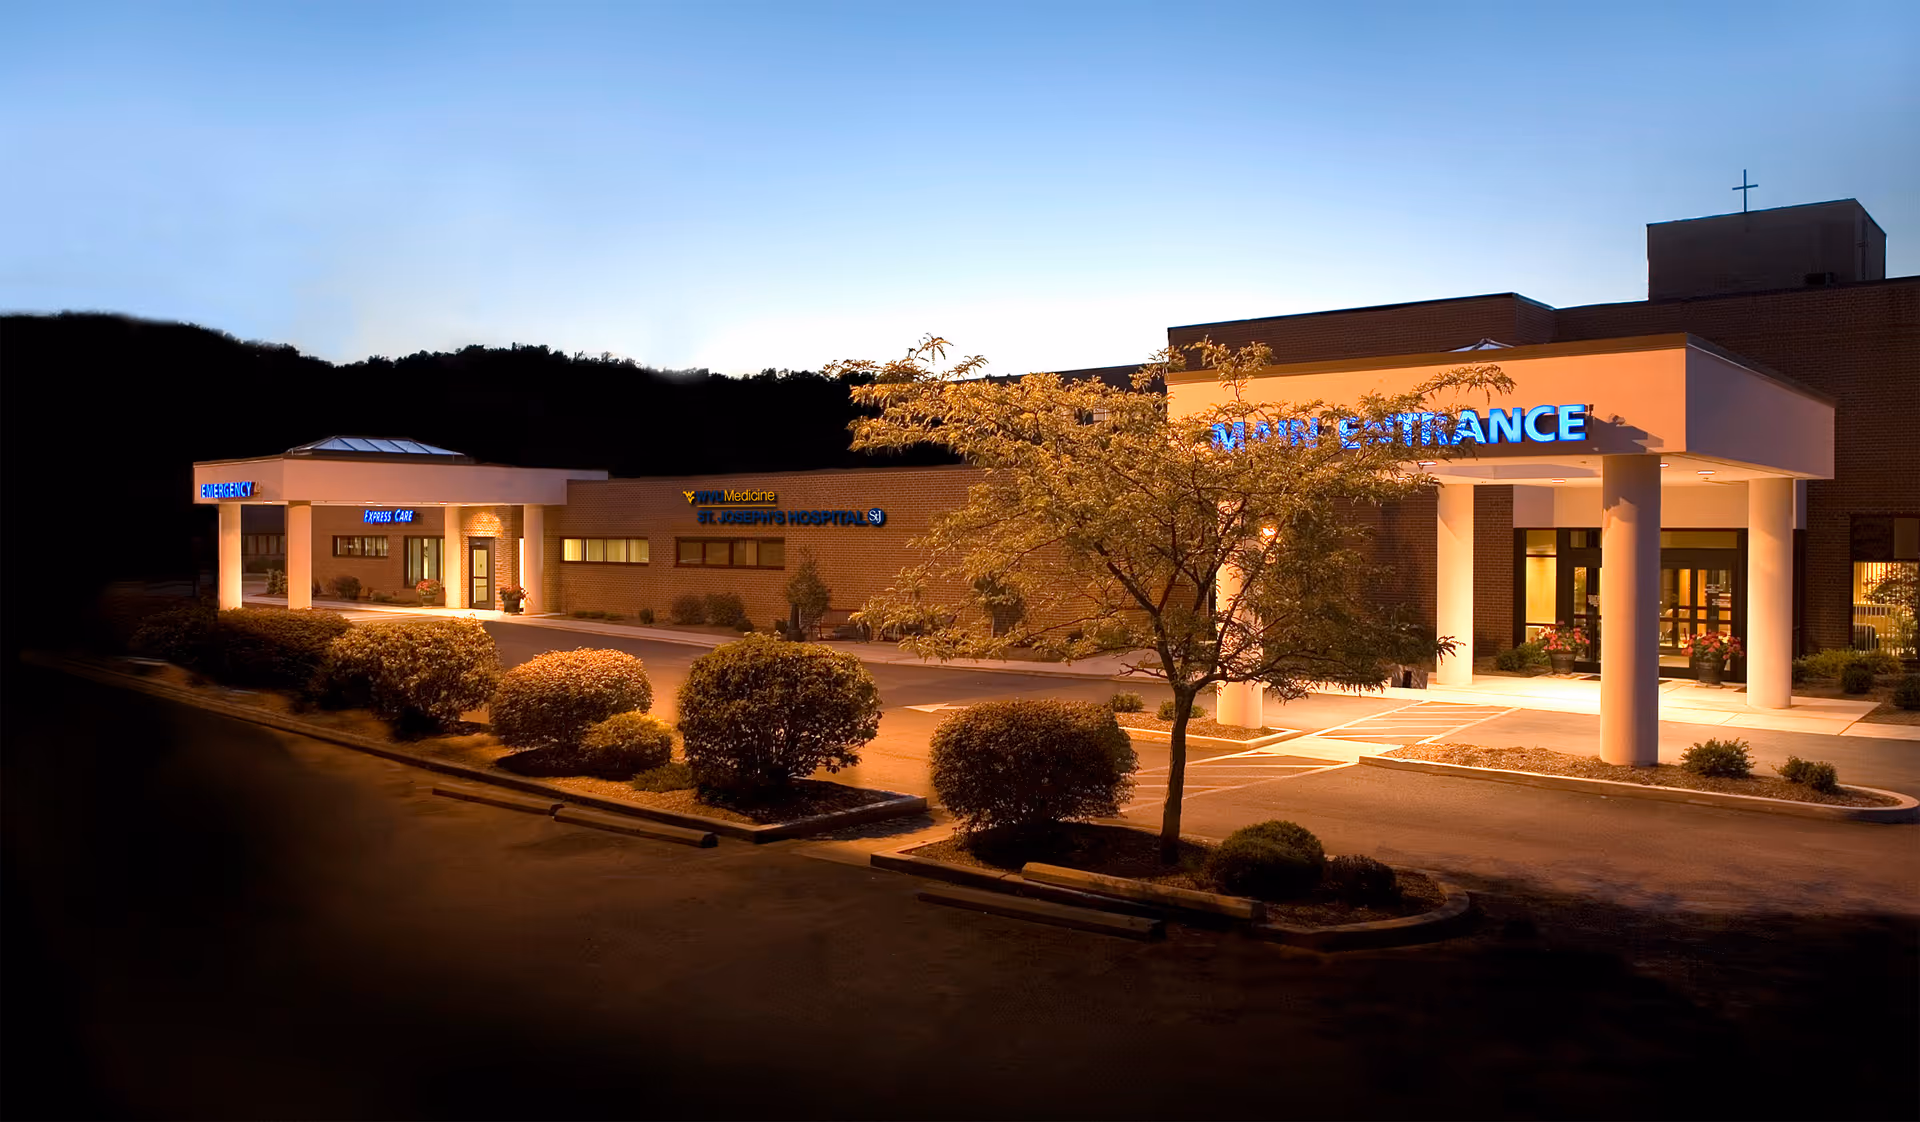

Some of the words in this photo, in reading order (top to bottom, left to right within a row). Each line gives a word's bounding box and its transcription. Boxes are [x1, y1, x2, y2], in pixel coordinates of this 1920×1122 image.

[201, 481, 252, 498] EMERGENCY
[394, 508, 414, 523] CARE
[697, 510, 714, 523] ST.
[717, 510, 785, 524] JOSEPH'S
[787, 510, 867, 524] HOSPITAL
